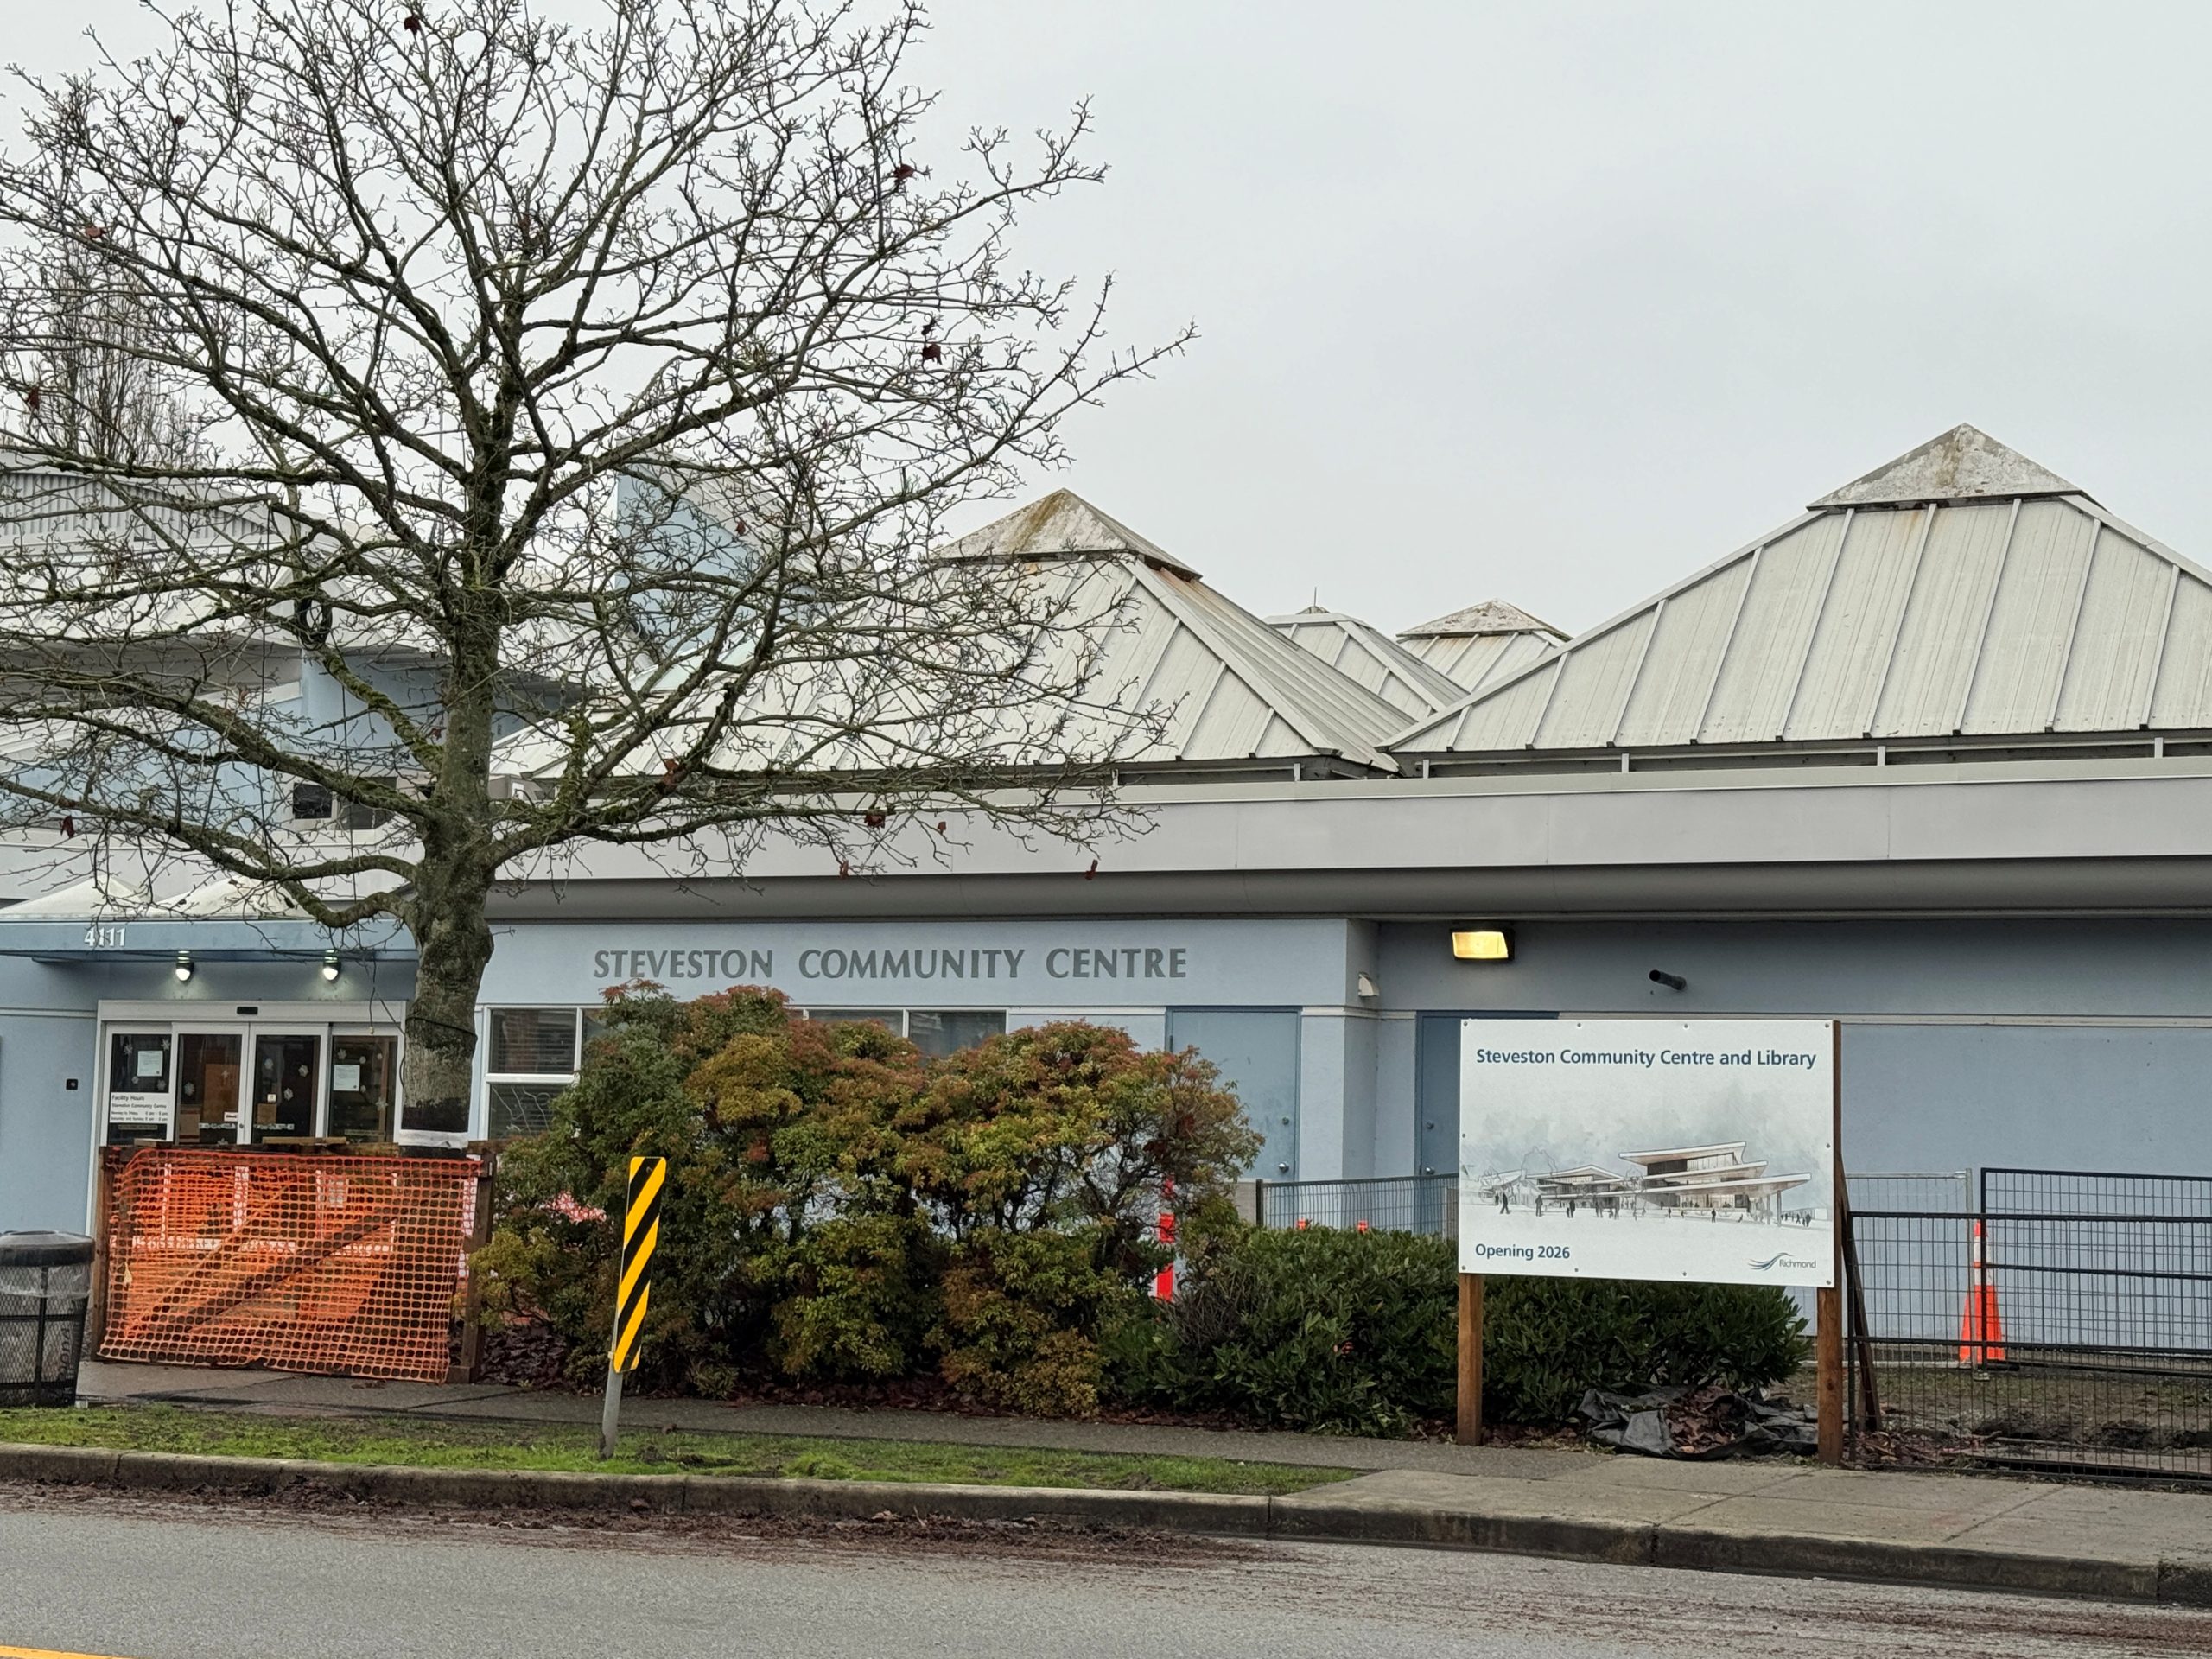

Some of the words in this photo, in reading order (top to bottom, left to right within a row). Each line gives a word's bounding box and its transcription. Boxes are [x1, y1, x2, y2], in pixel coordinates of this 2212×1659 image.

[84, 927, 125, 947] 4111
[594, 949, 773, 978] STEVESTON
[798, 949, 1026, 979] COMMUNITY
[1046, 948, 1186, 978] CENTRE
[1476, 1048, 1555, 1064] Steveston
[1560, 1049, 1656, 1068] Community
[1660, 1050, 1715, 1065] Centre
[1719, 1050, 1751, 1065] and
[1758, 1050, 1816, 1070] Library
[1475, 1243, 1534, 1261] Opening
[1537, 1245, 1570, 1259] 2026
[1779, 1259, 1816, 1268] Richmond
